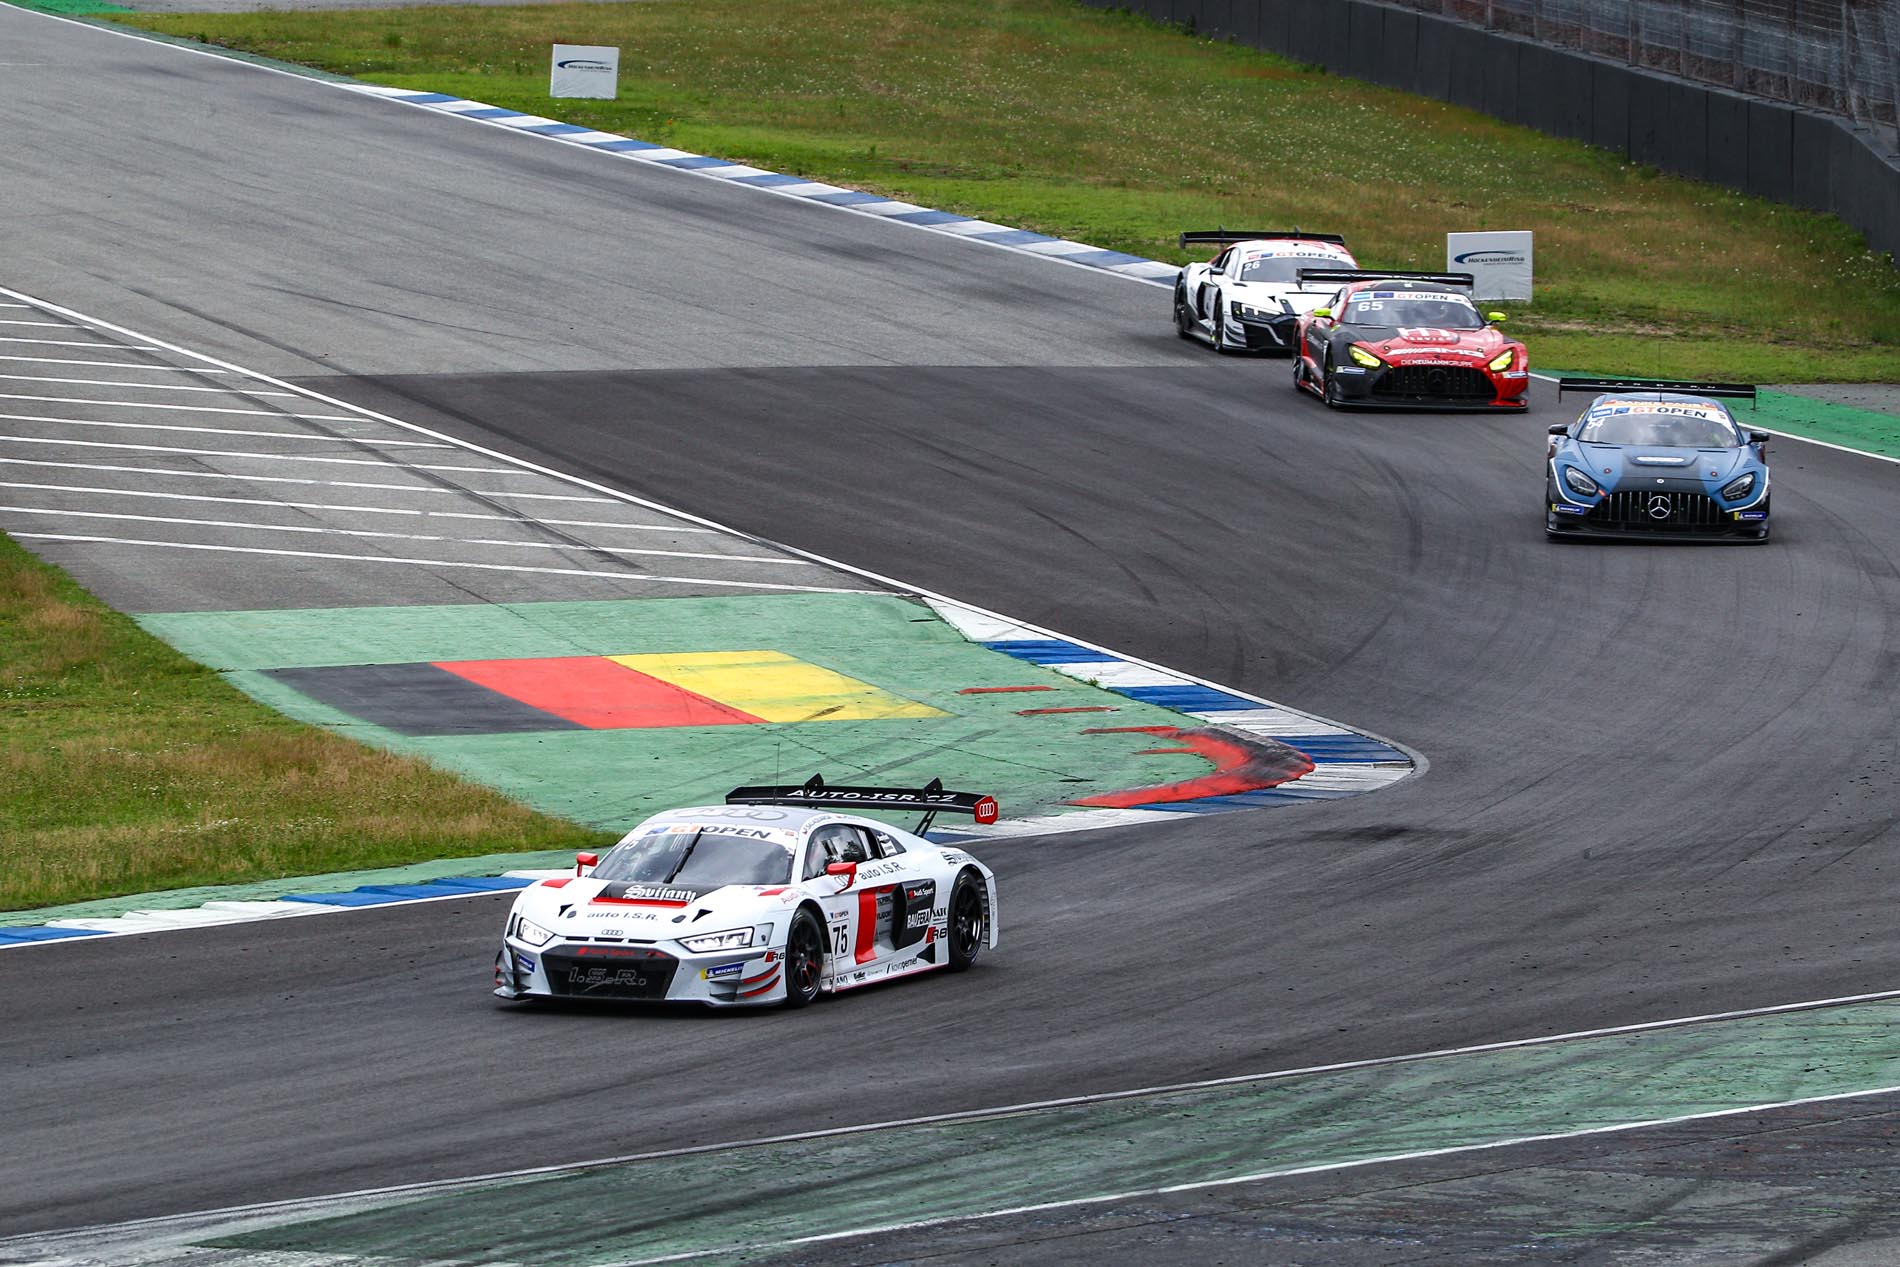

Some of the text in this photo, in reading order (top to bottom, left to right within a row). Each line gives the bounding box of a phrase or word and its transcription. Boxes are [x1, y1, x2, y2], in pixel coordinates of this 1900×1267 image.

[1243, 260, 1261, 272] 26
[1357, 301, 1385, 312] 65
[858, 868, 882, 881] auto
[587, 910, 620, 920] auto
[832, 924, 849, 956] 75
